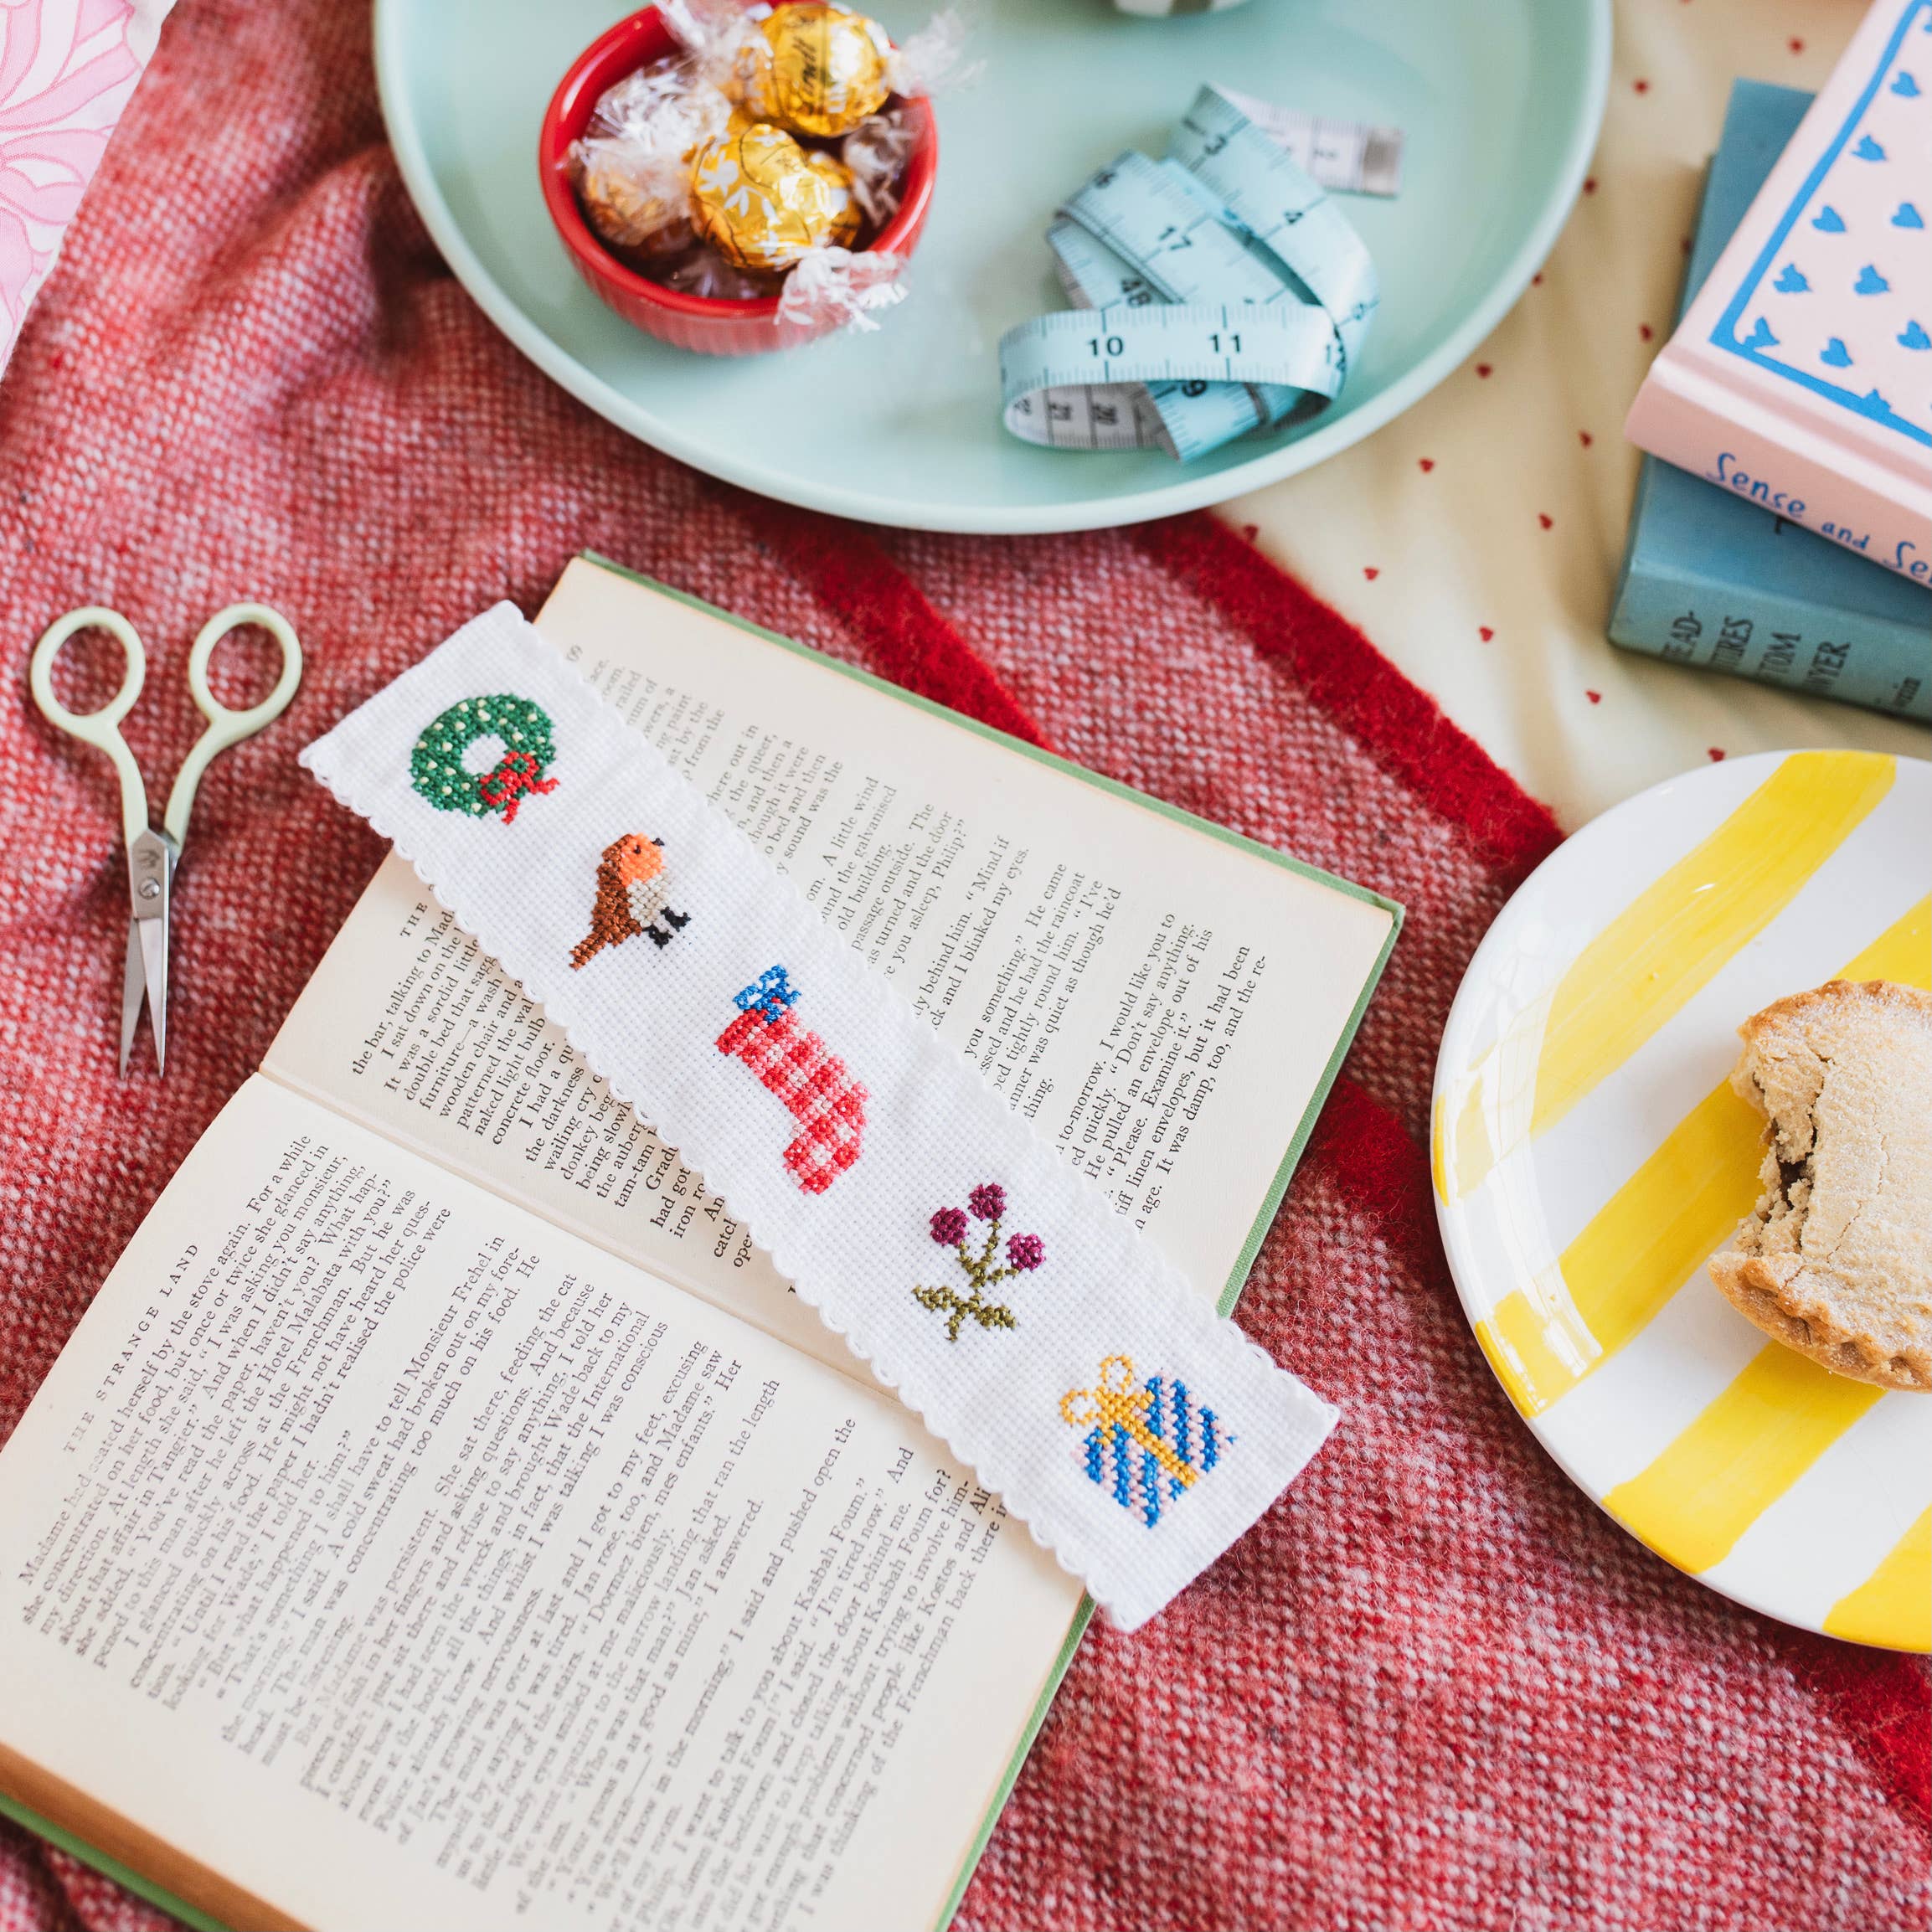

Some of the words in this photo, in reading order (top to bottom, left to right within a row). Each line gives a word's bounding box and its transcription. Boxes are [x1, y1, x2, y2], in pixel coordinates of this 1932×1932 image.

[1087, 335, 1125, 358] 10
[1208, 333, 1244, 353] 11
[1716, 452, 1806, 515] Sense
[1821, 521, 1871, 550] and
[399, 901, 429, 937] THE
[918, 941, 956, 994] behind
[945, 911, 973, 942] him.
[993, 835, 1009, 850] if
[1191, 929, 1213, 952] his
[963, 1028, 985, 1059] you
[1023, 904, 1046, 928] He
[1043, 863, 1067, 900] came
[1071, 924, 1105, 973] though
[1186, 953, 1200, 973] of
[1222, 945, 1250, 981] been
[352, 1050, 373, 1075] the
[363, 1021, 394, 1048] bar,
[384, 965, 425, 1016] talking
[415, 948, 431, 963] to
[379, 1047, 395, 1059] I
[390, 1024, 410, 1048] sat
[403, 982, 434, 1023] down
[430, 962, 446, 981] on
[440, 935, 461, 960] the
[475, 977, 503, 1012] wash
[1044, 996, 1069, 1033] quiet
[1064, 976, 1079, 993] as
[1099, 1038, 1115, 1051] I
[1109, 991, 1138, 1037] would
[1127, 962, 1152, 991] like
[1146, 932, 1167, 962] you
[1160, 913, 1176, 929] to
[1172, 977, 1191, 1003] out
[1207, 983, 1232, 1014] had
[383, 1076, 402, 1093] It
[398, 1043, 421, 1070] was
[419, 1028, 430, 1038] a
[426, 975, 460, 1023] sordid
[403, 1049, 438, 1101] double
[430, 1018, 456, 1048] bed
[450, 988, 475, 1017] that
[438, 1061, 477, 1116] wooden
[472, 1019, 499, 1059] chair
[496, 988, 518, 1019] and
[1027, 1036, 1048, 1064] was
[1081, 1087, 1116, 1144] quickly.
[1142, 992, 1163, 1018] say
[1156, 924, 1196, 990] anything.
[1138, 1008, 1175, 1073] envelope
[1183, 1035, 1208, 1063] but
[1203, 1018, 1217, 1032] it
[456, 1054, 502, 1131] patterned
[496, 1028, 517, 1052] the
[473, 1088, 505, 1136] naked
[495, 1054, 525, 1089] light
[516, 1017, 546, 1051] bulb
[492, 1081, 531, 1146] concrete
[524, 1042, 556, 1079] floor.
[518, 1115, 534, 1129] I
[526, 1082, 553, 1114] had
[549, 1069, 561, 1079] a
[1126, 1078, 1143, 1098] an
[1139, 1042, 1182, 1109] Examine
[1141, 1185, 1162, 1214] age.
[1155, 1157, 1174, 1175] It
[1167, 1125, 1190, 1153] was
[1182, 1076, 1216, 1121] damp,
[1206, 1043, 1232, 1069] too,
[1224, 1006, 1244, 1037] and
[1236, 980, 1256, 1003] the
[1151, 1070, 1196, 1144] envelopes,
[525, 1137, 545, 1162] the
[541, 1066, 585, 1131] darkness
[543, 1115, 583, 1170] wailing
[576, 1085, 597, 1112] cry
[1101, 1100, 1131, 1152] pulled
[559, 1124, 599, 1180] donkey
[574, 1146, 611, 1190] being
[1082, 1154, 1105, 1180] He
[1125, 1149, 1156, 1188] linen
[595, 1172, 616, 1198] the
[649, 1194, 676, 1229] had
[672, 1167, 692, 1197] got
[668, 1204, 697, 1239] iron
[116, 1359, 159, 1419] herself
[151, 1337, 175, 1361] by
[169, 1310, 193, 1336] the
[188, 1267, 220, 1308] stove
[216, 1222, 251, 1265] again.
[245, 1184, 274, 1214] For
[271, 1174, 284, 1184] a
[278, 1136, 312, 1171] while
[95, 1306, 160, 1401] STRANGE
[158, 1244, 198, 1298] LAND
[107, 1460, 126, 1481] on
[117, 1426, 144, 1456] her
[137, 1384, 174, 1425] food,
[163, 1349, 192, 1379] but
[188, 1310, 216, 1347] once
[213, 1287, 229, 1307] or
[224, 1245, 258, 1286] twice
[254, 1217, 276, 1244] she
[273, 1159, 317, 1218] glanced
[308, 1145, 329, 1161] in
[387, 1382, 411, 1410] tell
[402, 1304, 459, 1381] Monsieur
[451, 1251, 493, 1303] Frehel
[484, 1236, 506, 1253] in
[434, 1464, 462, 1497] She
[458, 1435, 478, 1461] sat
[472, 1388, 510, 1432] there,
[499, 1325, 547, 1384] feeding
[538, 1298, 560, 1323] the
[557, 1273, 577, 1296] cat
[545, 1441, 572, 1476] that
[566, 1412, 590, 1439] the
[580, 1310, 651, 1409] International
[713, 1460, 735, 1488] ran
[729, 1430, 751, 1456] the
[741, 1379, 781, 1428] length
[761, 1551, 785, 1588] and
[779, 1487, 818, 1553] pushed
[813, 1448, 842, 1487] open
[833, 1418, 856, 1444] the
[792, 1547, 838, 1612] Kasbah
